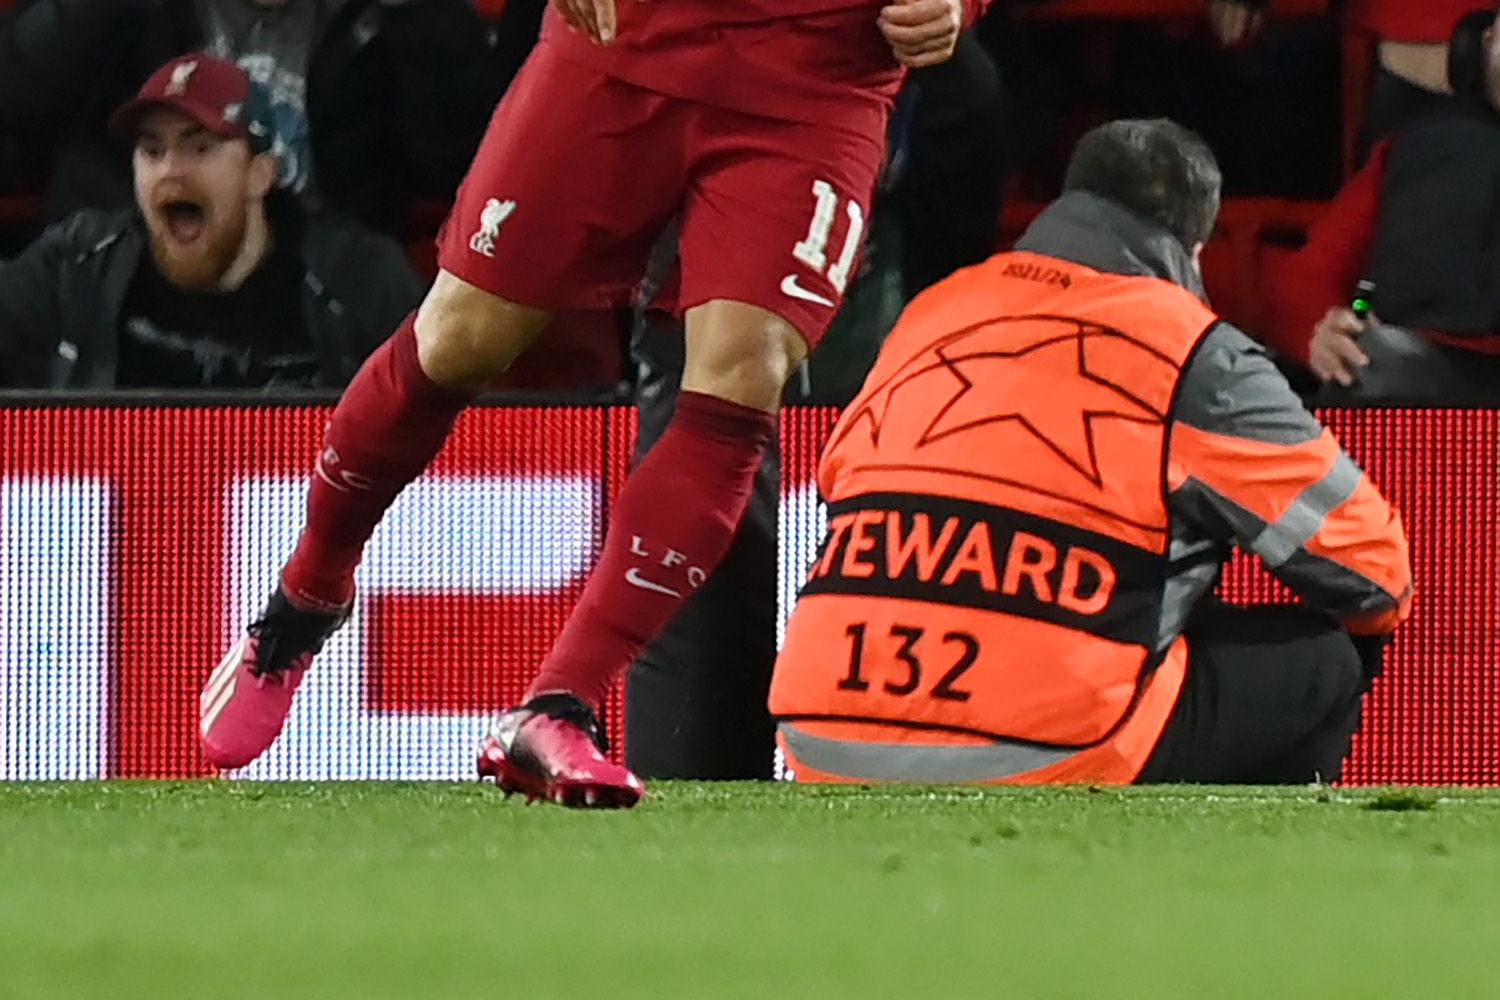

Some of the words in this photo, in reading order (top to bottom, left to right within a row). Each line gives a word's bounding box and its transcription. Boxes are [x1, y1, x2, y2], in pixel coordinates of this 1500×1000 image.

[792, 179, 863, 295] 11
[630, 534, 707, 588] LFC
[808, 509, 1117, 615] TEWARD
[837, 620, 981, 701] 132
